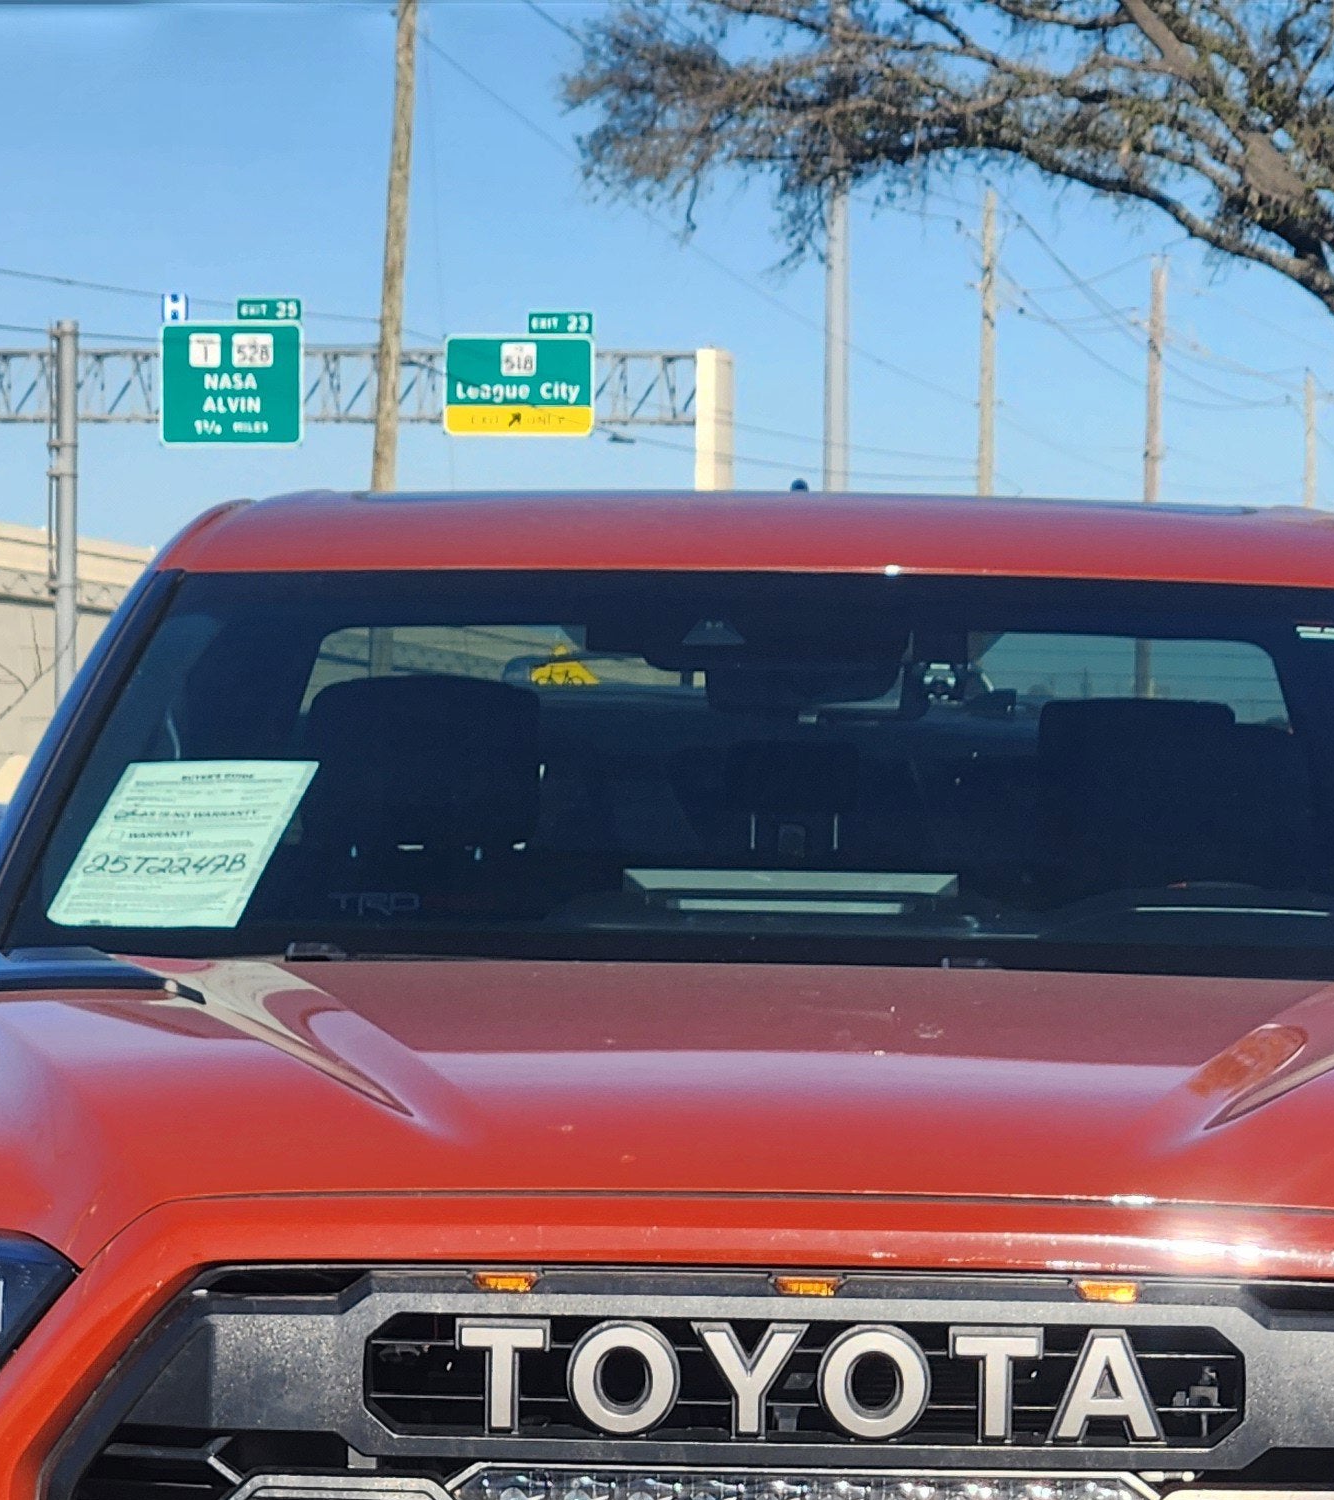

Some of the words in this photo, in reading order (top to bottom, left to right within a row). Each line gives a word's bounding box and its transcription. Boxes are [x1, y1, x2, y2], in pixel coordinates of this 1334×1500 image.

[567, 315, 589, 332] 23
[204, 373, 257, 390] NASA
[456, 381, 530, 403] League
[540, 381, 580, 404] City
[202, 396, 261, 414] ALVIN
[455, 1318, 1166, 1443] TOYOTA
